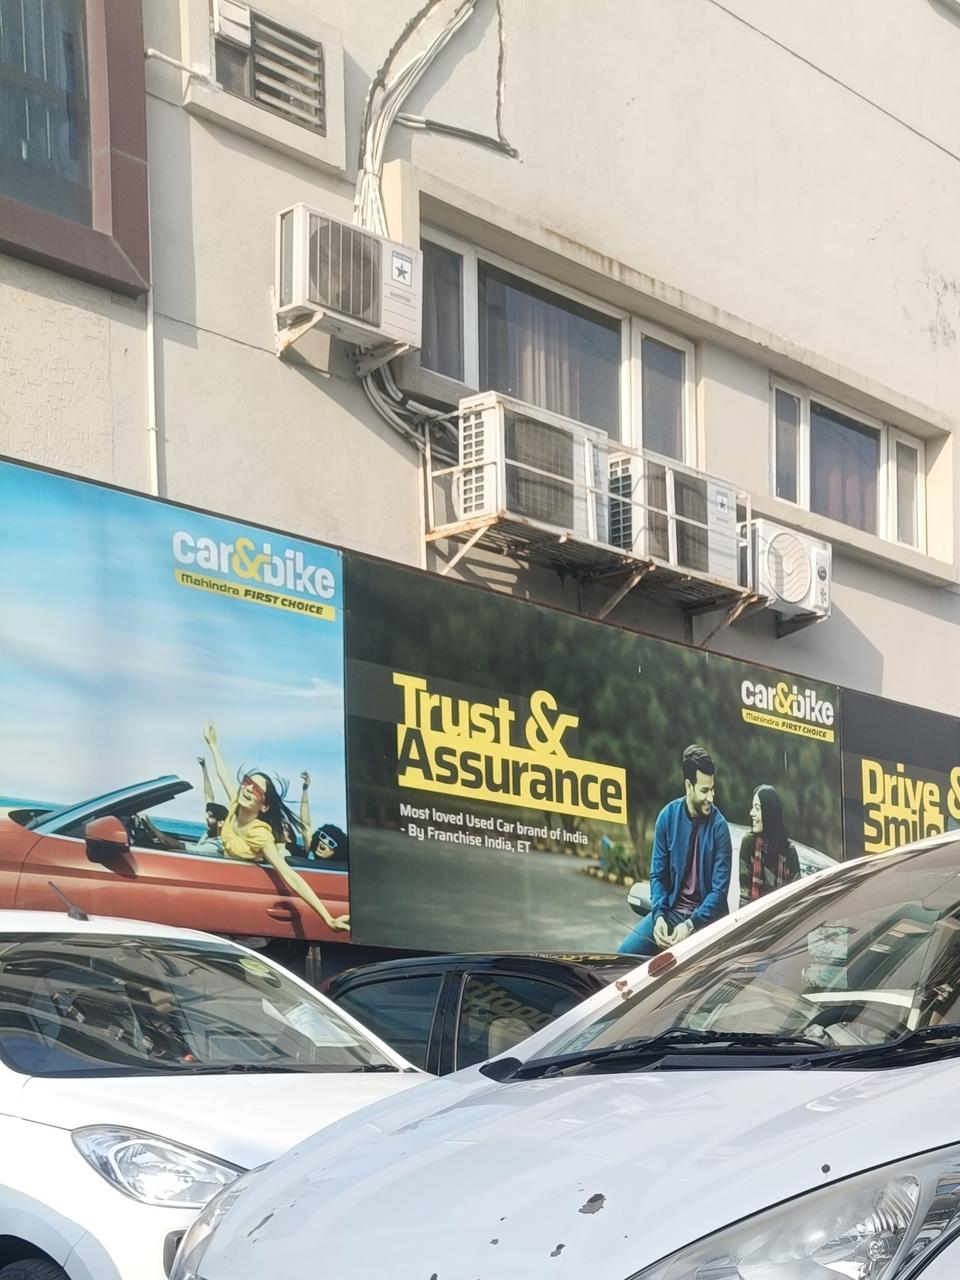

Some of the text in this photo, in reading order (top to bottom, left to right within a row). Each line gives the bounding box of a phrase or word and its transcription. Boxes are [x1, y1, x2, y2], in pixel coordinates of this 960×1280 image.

[173, 531, 336, 599] car&bike
[244, 588, 280, 604] FIRST
[280, 598, 324, 615] CHOICE
[392, 672, 579, 758] Trust &
[741, 680, 835, 726] car&bike
[781, 721, 802, 732] FIRST
[802, 726, 828, 738] CHOICE
[398, 726, 623, 815] Assurance
[861, 758, 941, 812] Drive
[400, 803, 589, 845] Most loved Used Car brand of India
[408, 823, 424, 841] By
[427, 826, 482, 847] Franchise
[484, 835, 515, 853] India,
[517, 840, 532, 853] ET
